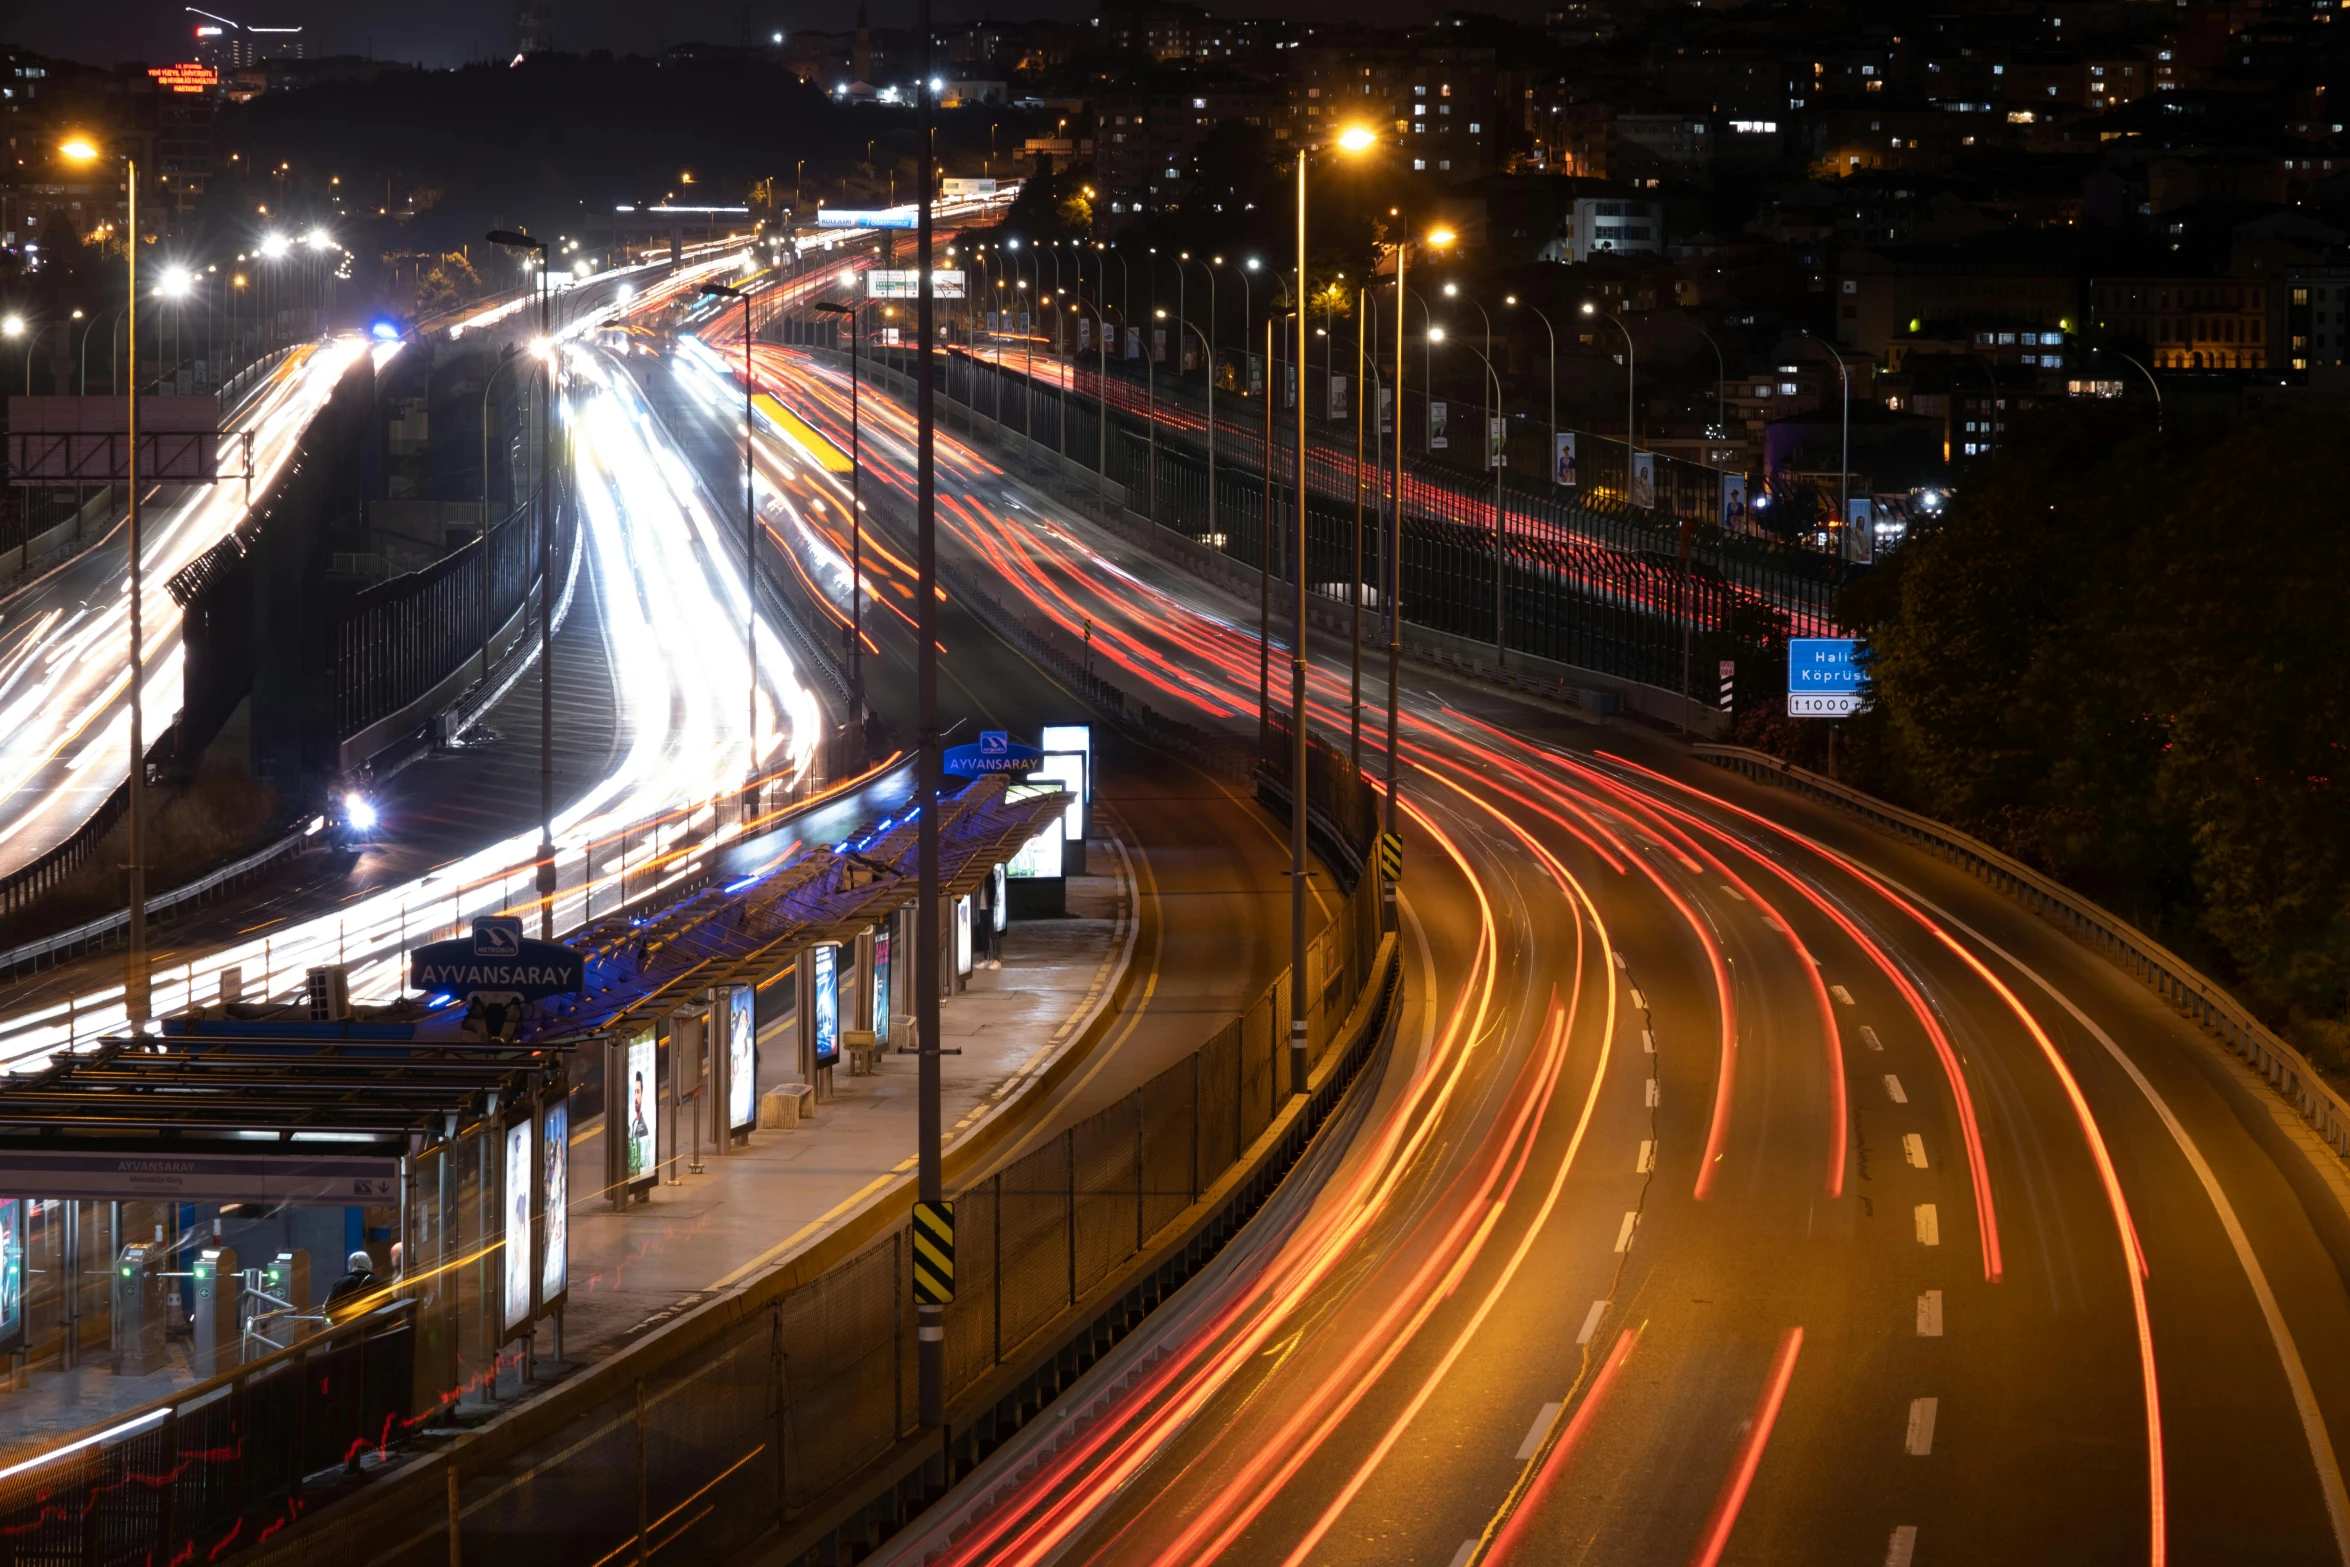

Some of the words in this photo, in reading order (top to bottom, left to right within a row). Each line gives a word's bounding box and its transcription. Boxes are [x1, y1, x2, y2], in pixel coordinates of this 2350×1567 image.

[950, 758, 1038, 770] AYVANSARAY
[477, 946, 515, 954] METROBÜS
[421, 965, 572, 985] AYVANSARAY
[118, 1160, 195, 1172] AYVANSARAY
